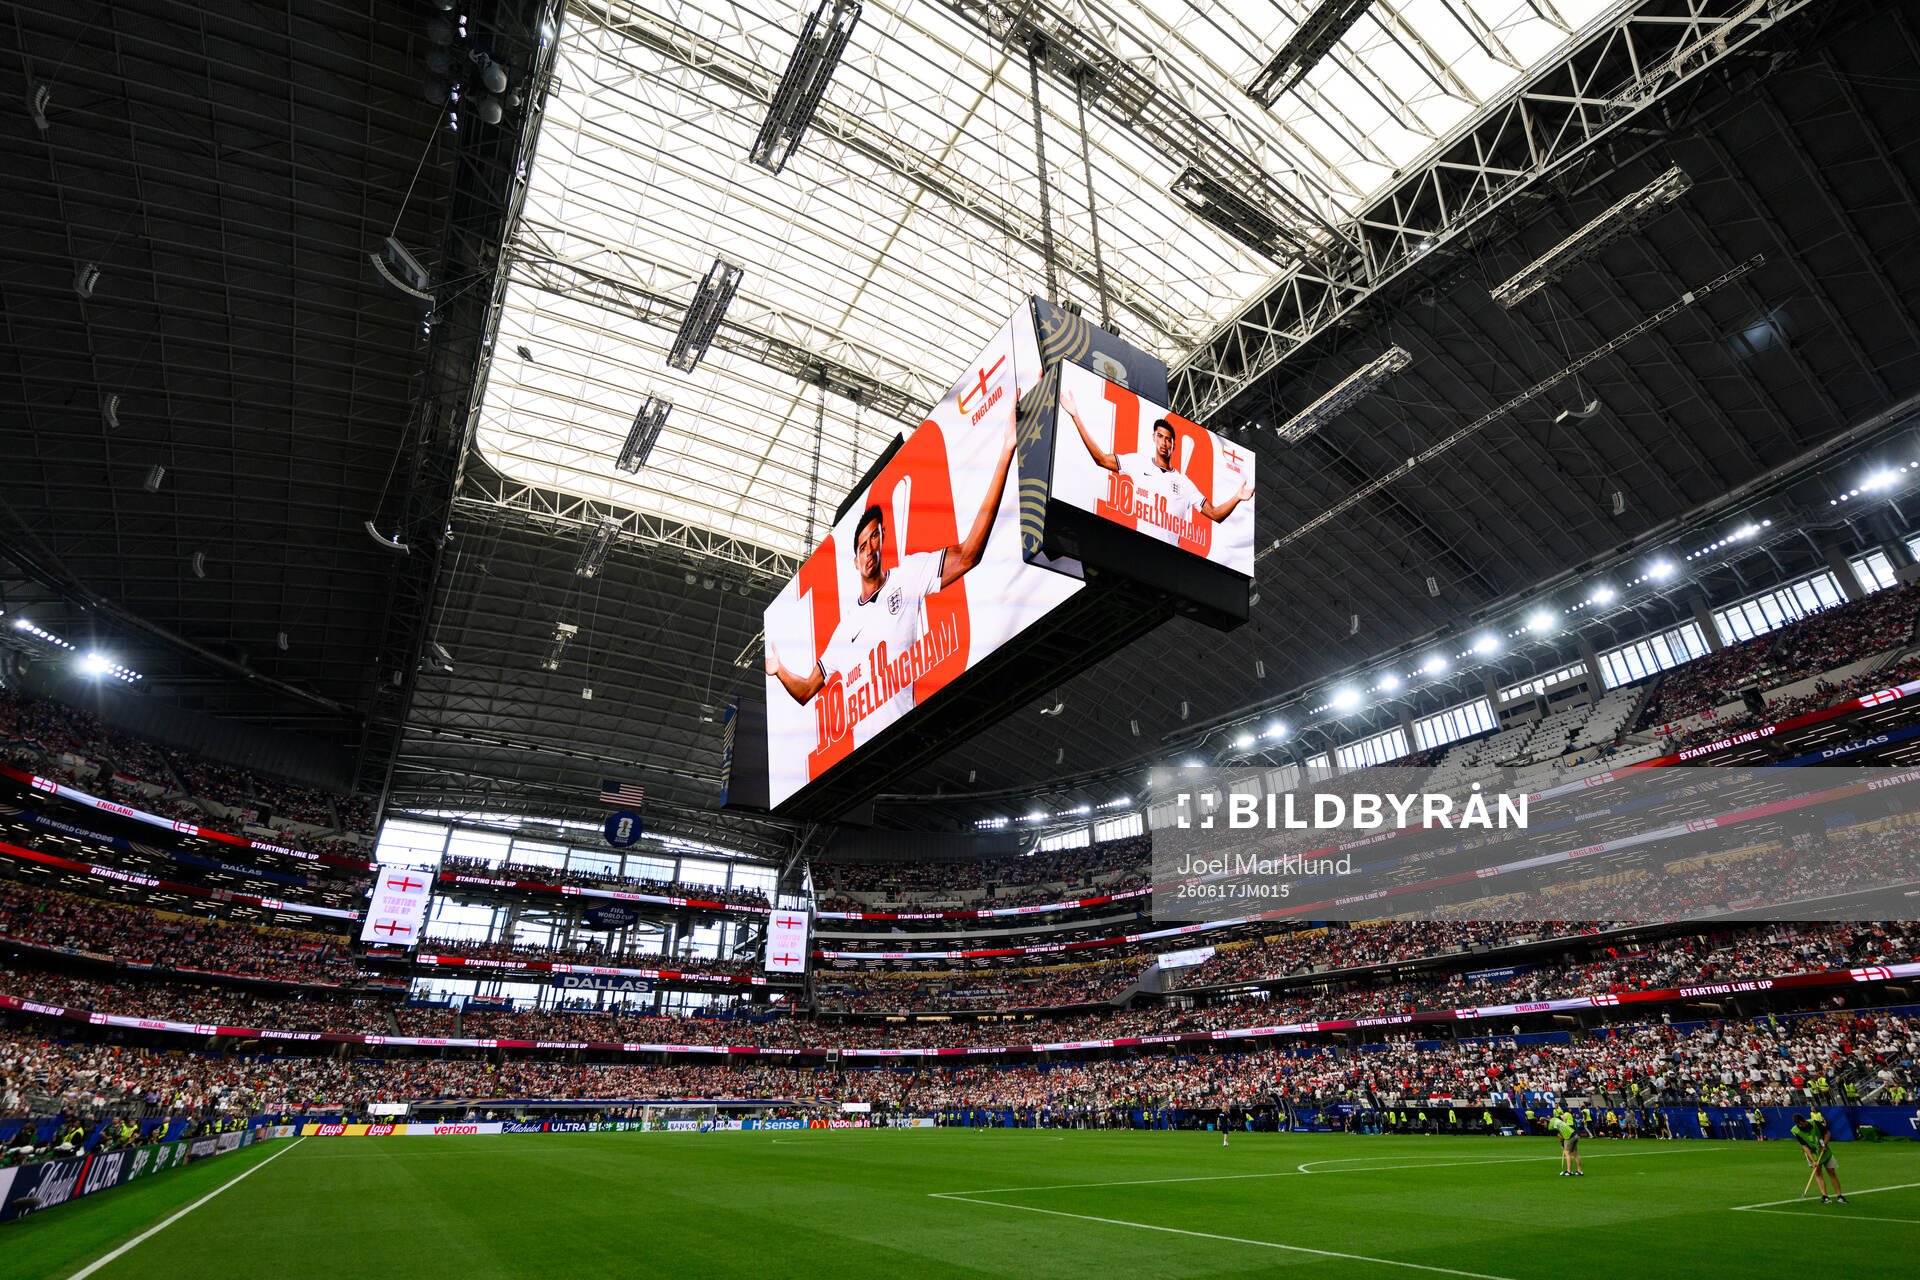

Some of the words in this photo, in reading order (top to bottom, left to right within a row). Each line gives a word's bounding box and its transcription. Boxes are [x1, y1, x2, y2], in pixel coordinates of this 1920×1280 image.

[971, 386, 1003, 427] ENGLAND
[1107, 473, 1135, 517] 10
[1135, 501, 1206, 547] BELLINGHAM
[846, 663, 862, 688] JUDE
[847, 613, 959, 730] BELLINGHAM
[814, 671, 848, 756] 10
[1679, 738, 1732, 761] STARTING
[1733, 731, 1760, 746] LINE
[1761, 726, 1777, 737] UP
[1822, 735, 1889, 758] DALLAS
[96, 800, 134, 818] ENGLAND
[36, 816, 51, 826] FIFA
[51, 821, 74, 832] WORLD
[74, 827, 90, 837] CUP
[89, 832, 114, 843] 2026
[1339, 838, 1371, 851] STARTING
[1371, 834, 1386, 843] LINE
[1387, 831, 1397, 839] UP
[251, 841, 289, 855] STARTING
[290, 849, 307, 859] LINE
[307, 853, 320, 861] UP
[1568, 844, 1605, 858] ENGLAND
[91, 867, 128, 881] STARTING
[129, 875, 147, 886] LINE
[148, 879, 160, 887] UP
[221, 863, 263, 876] DALLAS
[455, 875, 490, 884] STARTING
[490, 879, 507, 887] LINE
[612, 892, 640, 900] ENGLAND
[1335, 895, 1364, 906] STARTING
[1364, 892, 1379, 900] LINE
[1379, 890, 1387, 898] UP
[598, 911, 621, 919] WORLD
[465, 959, 500, 967] STARTING
[563, 976, 649, 992] DALLAS
[1680, 985, 1730, 997] STARTING
[1732, 982, 1756, 992] LINE
[1758, 980, 1774, 989] UP
[1514, 1003, 1551, 1012] ENGLAND
[139, 1020, 166, 1029] ENGLAND
[1356, 1017, 1387, 1027] STARTING
[1388, 1016, 1402, 1024] LINE
[1403, 1015, 1412, 1023] UP
[261, 1031, 293, 1040] STARTING
[319, 1124, 343, 1136] Lay's
[368, 1124, 392, 1136] Lay's
[433, 1125, 478, 1134] verizon
[503, 1122, 541, 1133] Michelob
[551, 1123, 586, 1132] ULTRA
[84, 1152, 125, 1195] ULTRA
